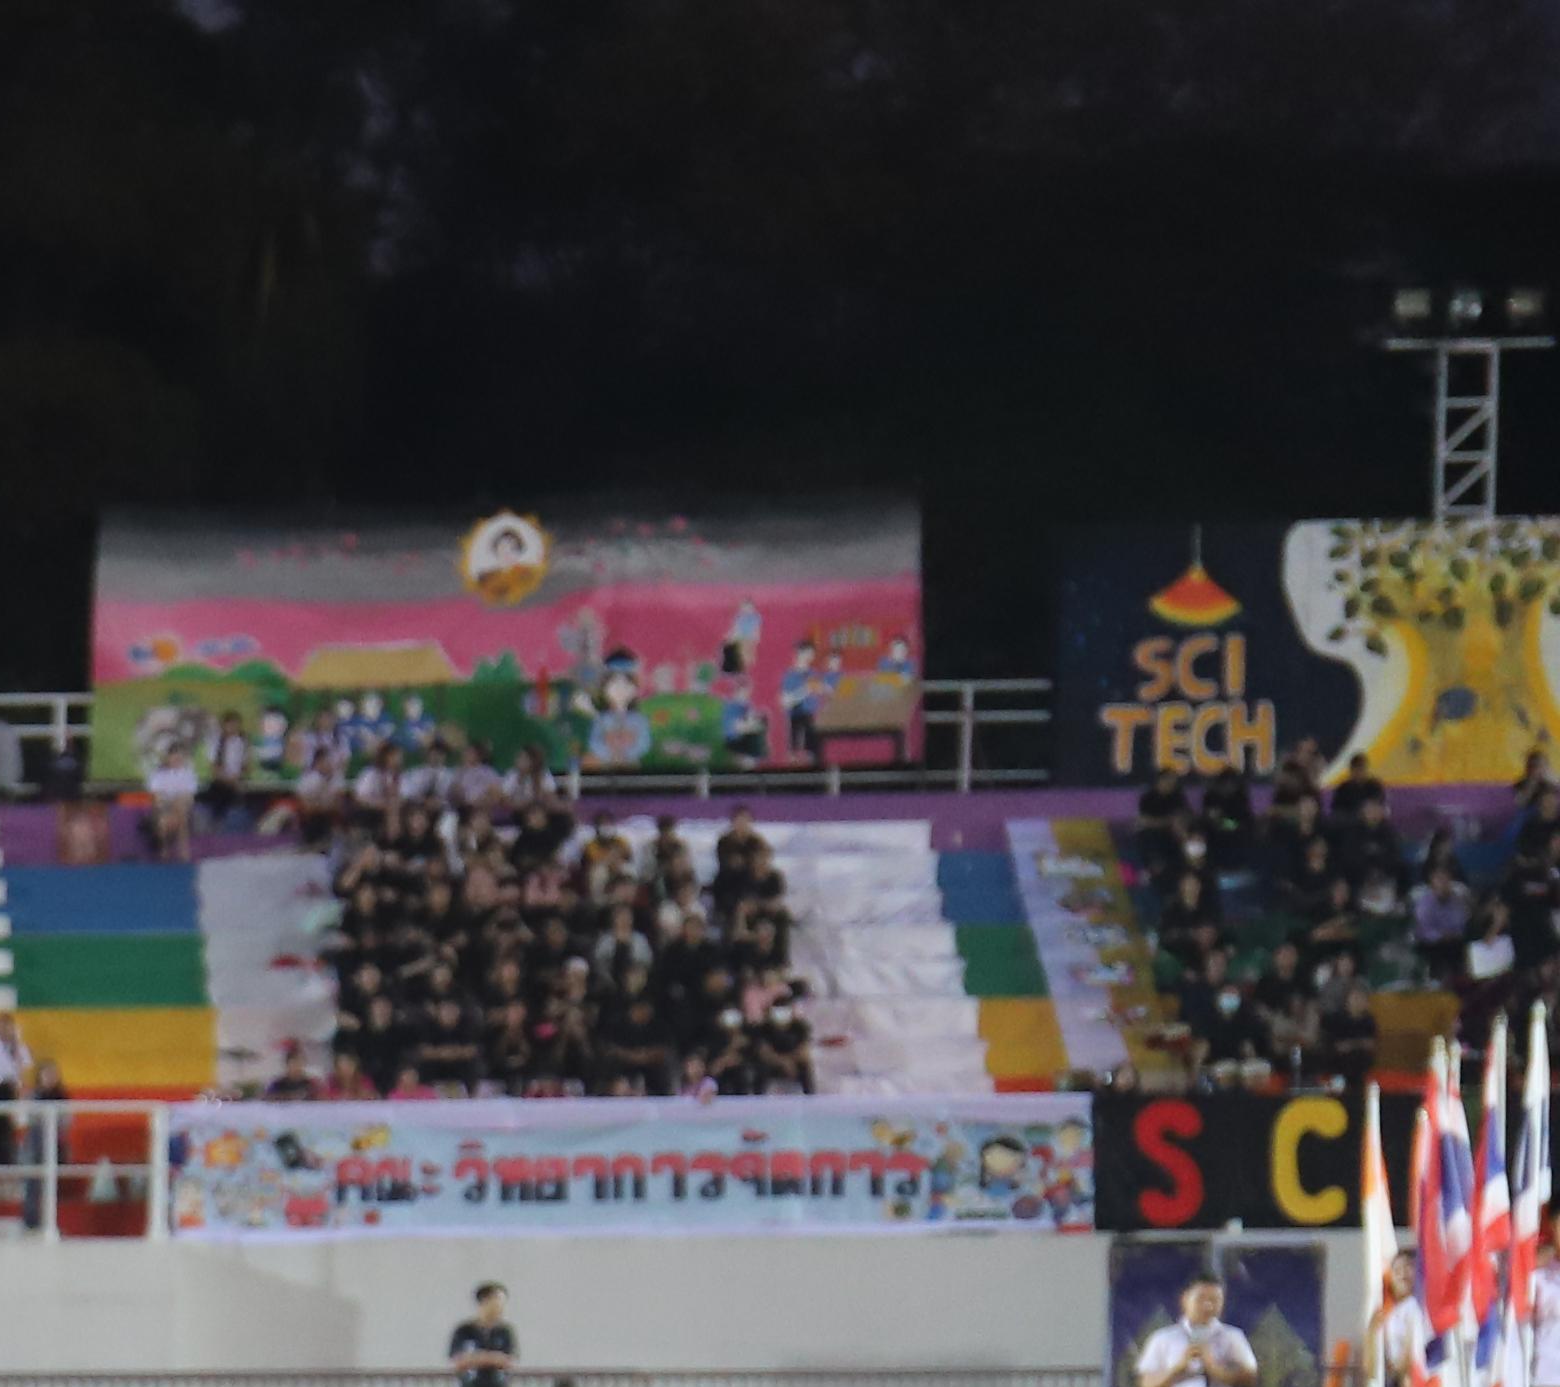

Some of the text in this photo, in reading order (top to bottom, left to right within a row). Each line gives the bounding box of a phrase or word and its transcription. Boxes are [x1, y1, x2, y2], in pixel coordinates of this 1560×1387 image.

[1135, 633, 1247, 702] SCI
[1100, 701, 1277, 777] TECH
[1134, 1097, 1350, 1227] S C
